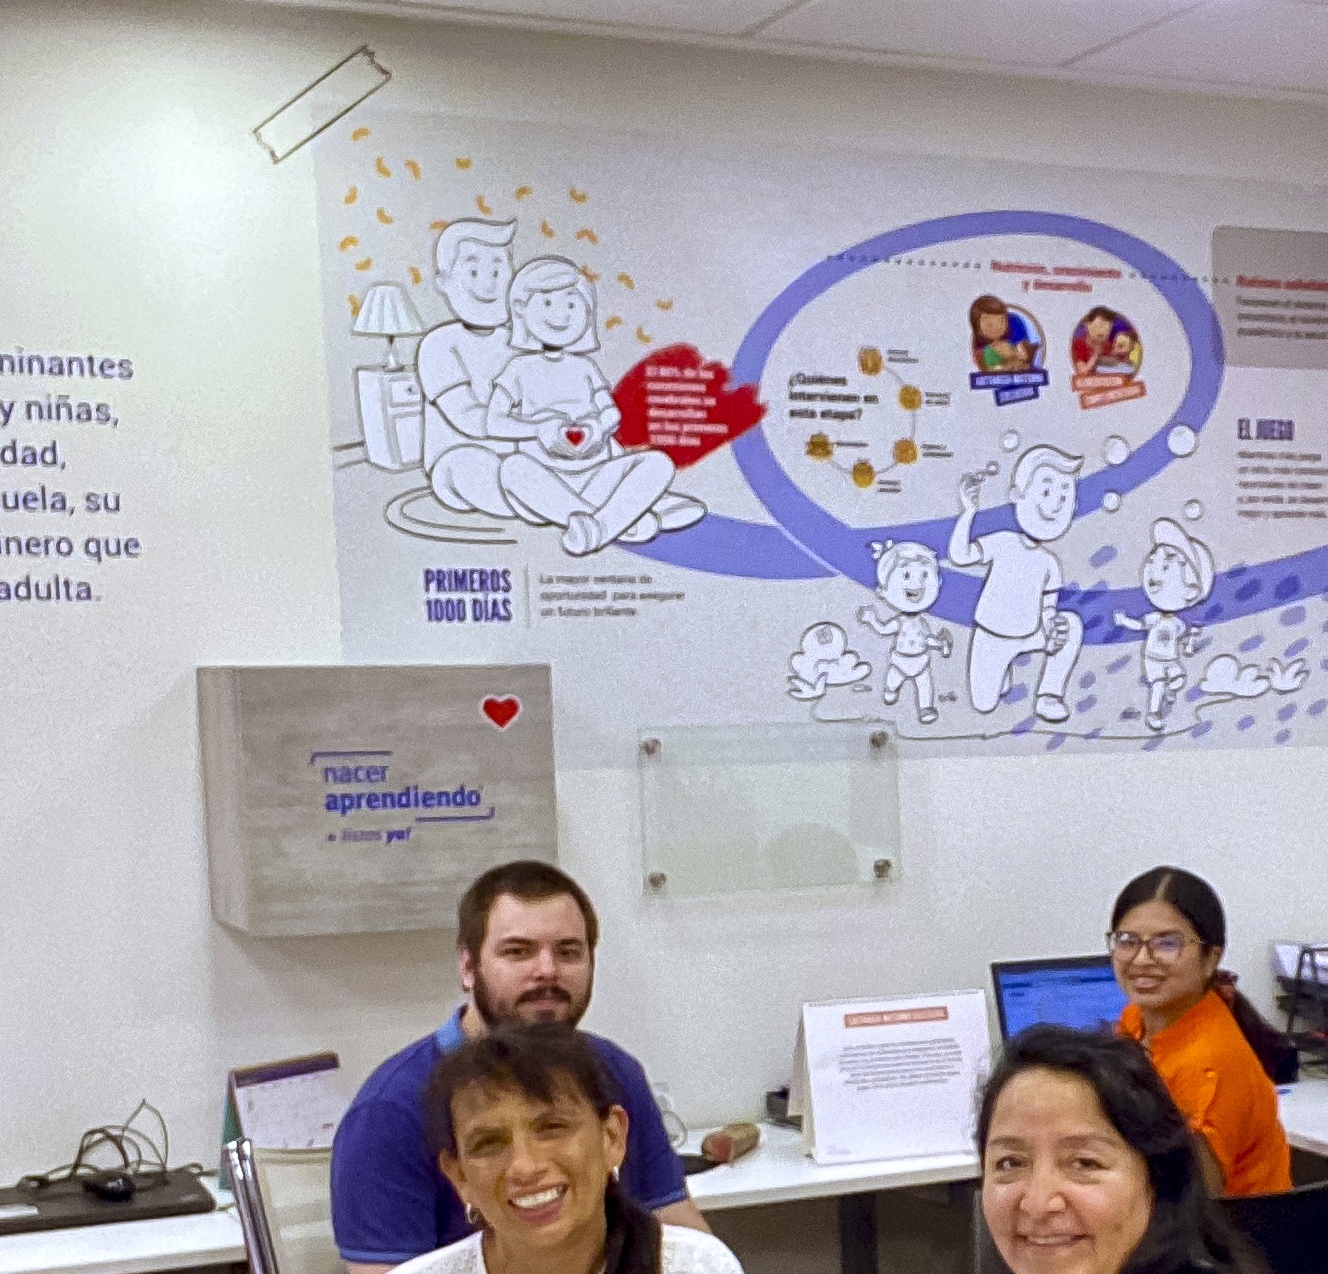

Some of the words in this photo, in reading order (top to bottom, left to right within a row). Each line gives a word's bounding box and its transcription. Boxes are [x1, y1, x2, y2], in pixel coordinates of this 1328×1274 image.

[25, 394, 119, 428] niñas,
[85, 491, 121, 514] su
[84, 536, 142, 564] que
[424, 568, 512, 593] PRIMEROS
[426, 597, 467, 623] 1000
[471, 593, 513, 623] DÍAS
[324, 765, 389, 784] nacer
[325, 784, 482, 818] aprendiendo
